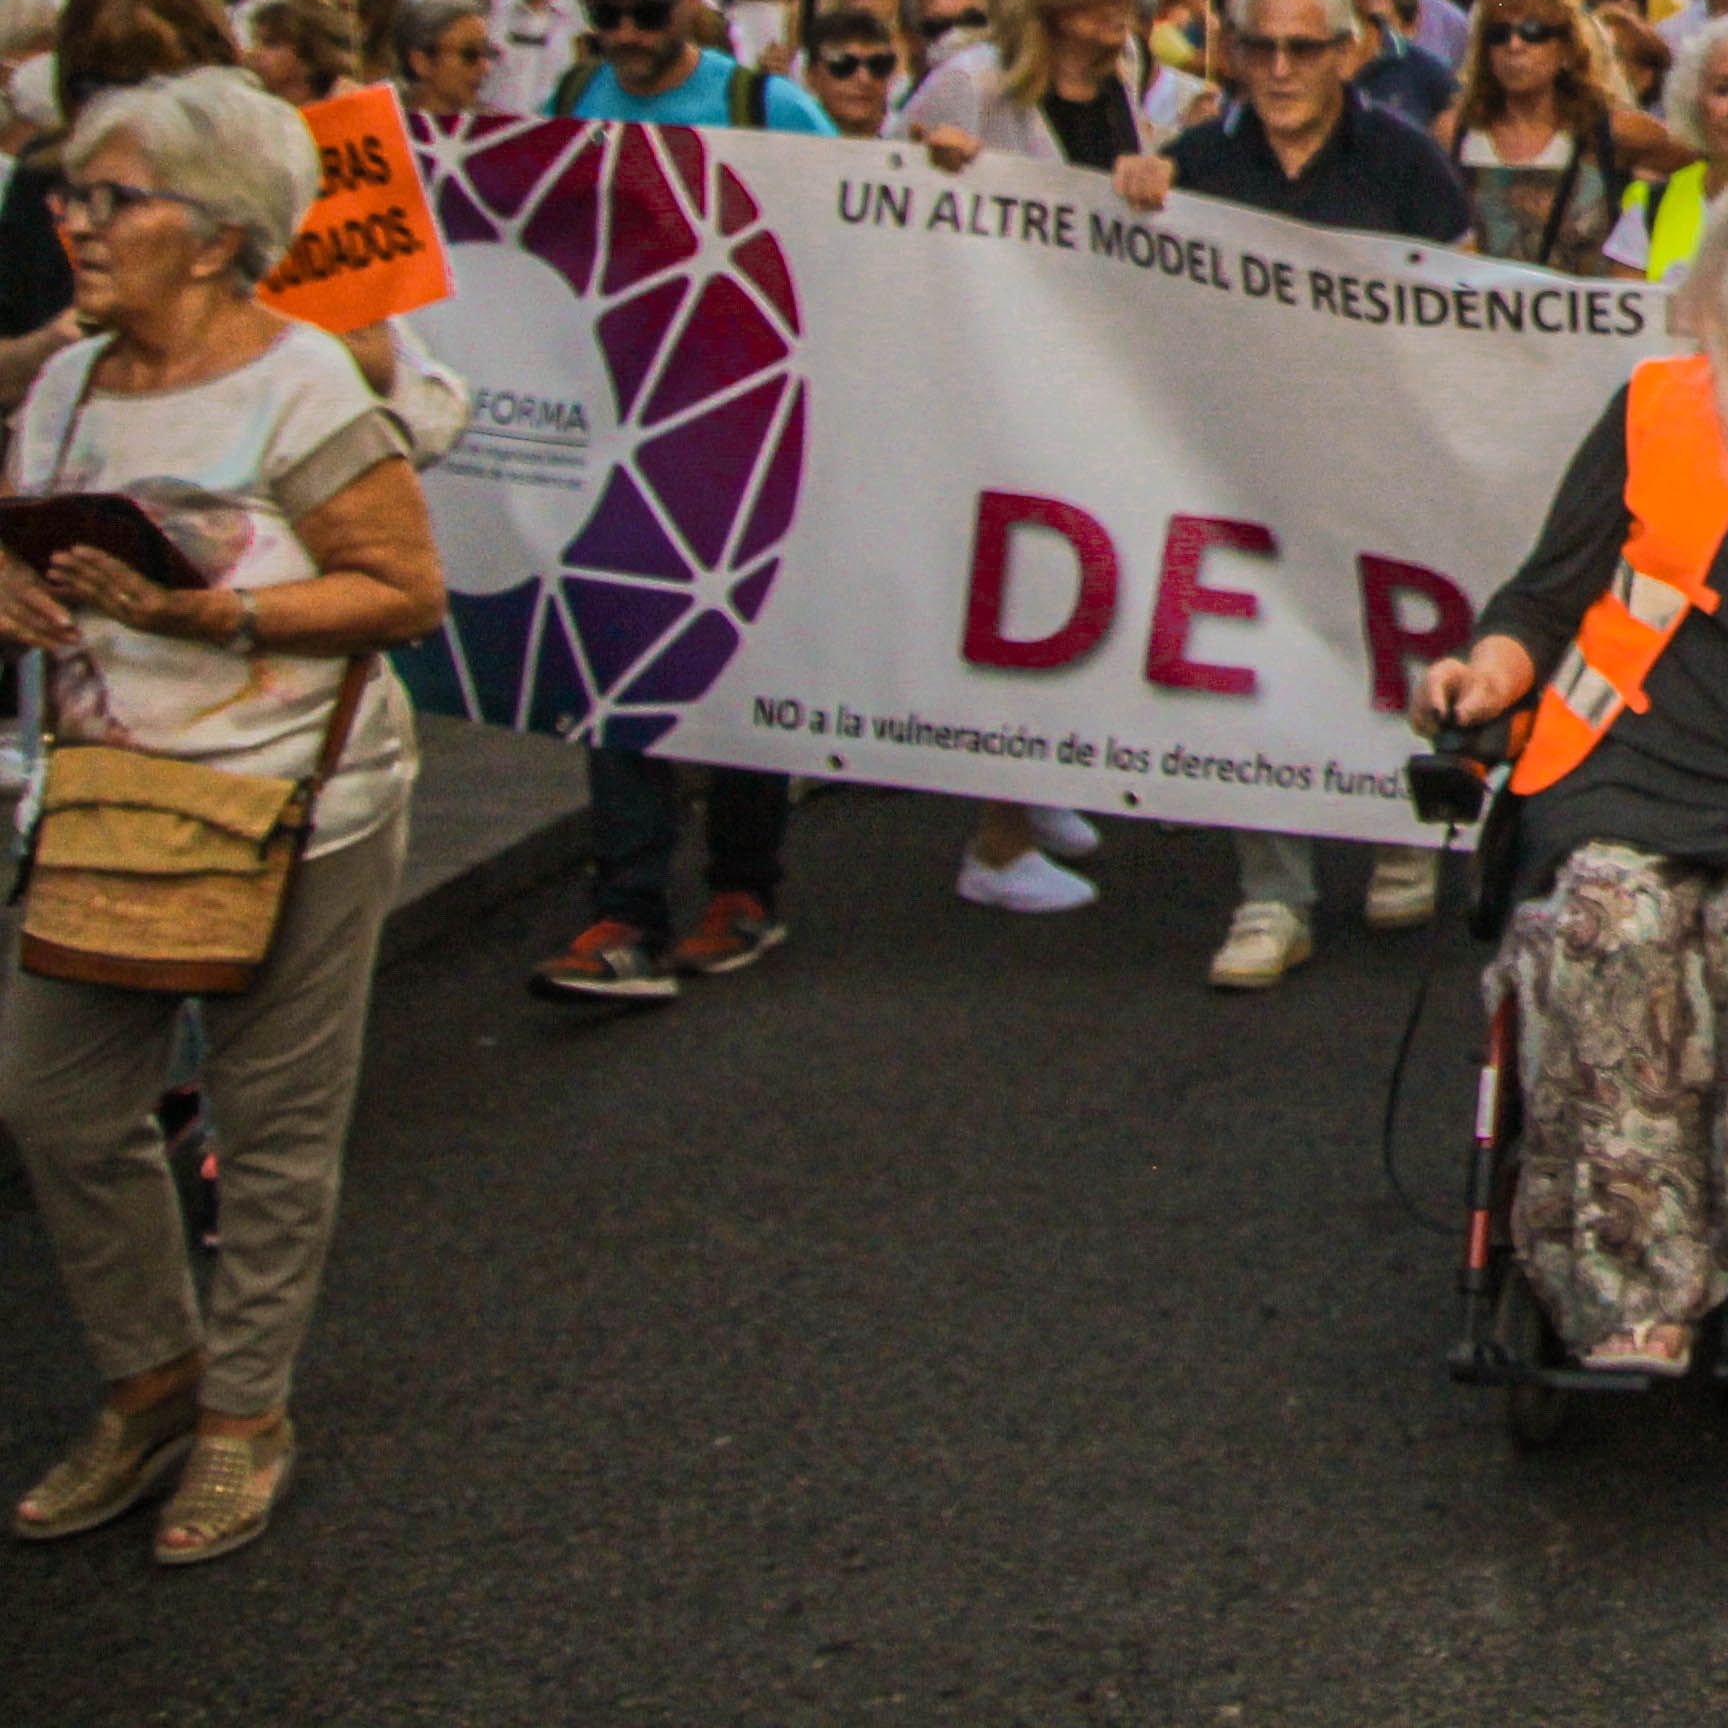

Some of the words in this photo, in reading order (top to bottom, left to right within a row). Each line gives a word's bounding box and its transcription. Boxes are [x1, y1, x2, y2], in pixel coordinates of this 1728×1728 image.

[837, 180, 912, 229] UN
[928, 189, 1075, 251] ALTRE
[1089, 214, 1230, 292] MODEL
[1242, 253, 1296, 305] DE
[1309, 268, 1645, 337] RESIDÈNCIES
[961, 488, 1280, 696] DE
[752, 696, 801, 731] NO
[809, 708, 826, 734] a
[835, 702, 862, 739] la
[873, 709, 1047, 763] vulneración
[1057, 730, 1098, 769] de
[1106, 736, 1150, 775] los
[1161, 745, 1312, 793] derechos
